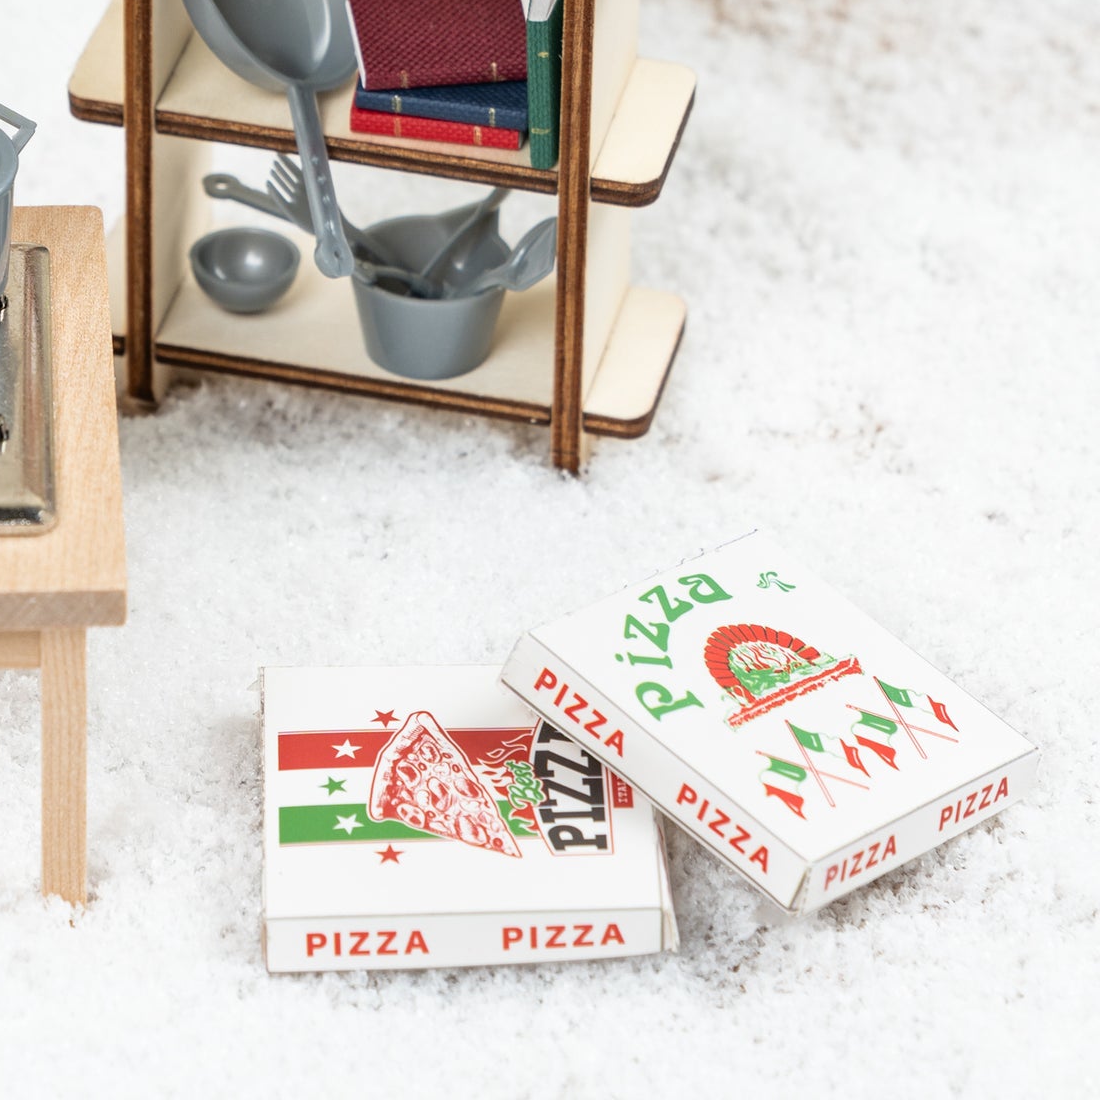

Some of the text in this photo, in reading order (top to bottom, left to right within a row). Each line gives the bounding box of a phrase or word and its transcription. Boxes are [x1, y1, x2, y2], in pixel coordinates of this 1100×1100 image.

[614, 573, 733, 722] pizza
[505, 759, 545, 808] Best
[533, 667, 770, 874] PIZZA PIZZA
[824, 776, 1009, 891] PIZZA PIZZA
[306, 923, 626, 957] PIZZA PIZZA
